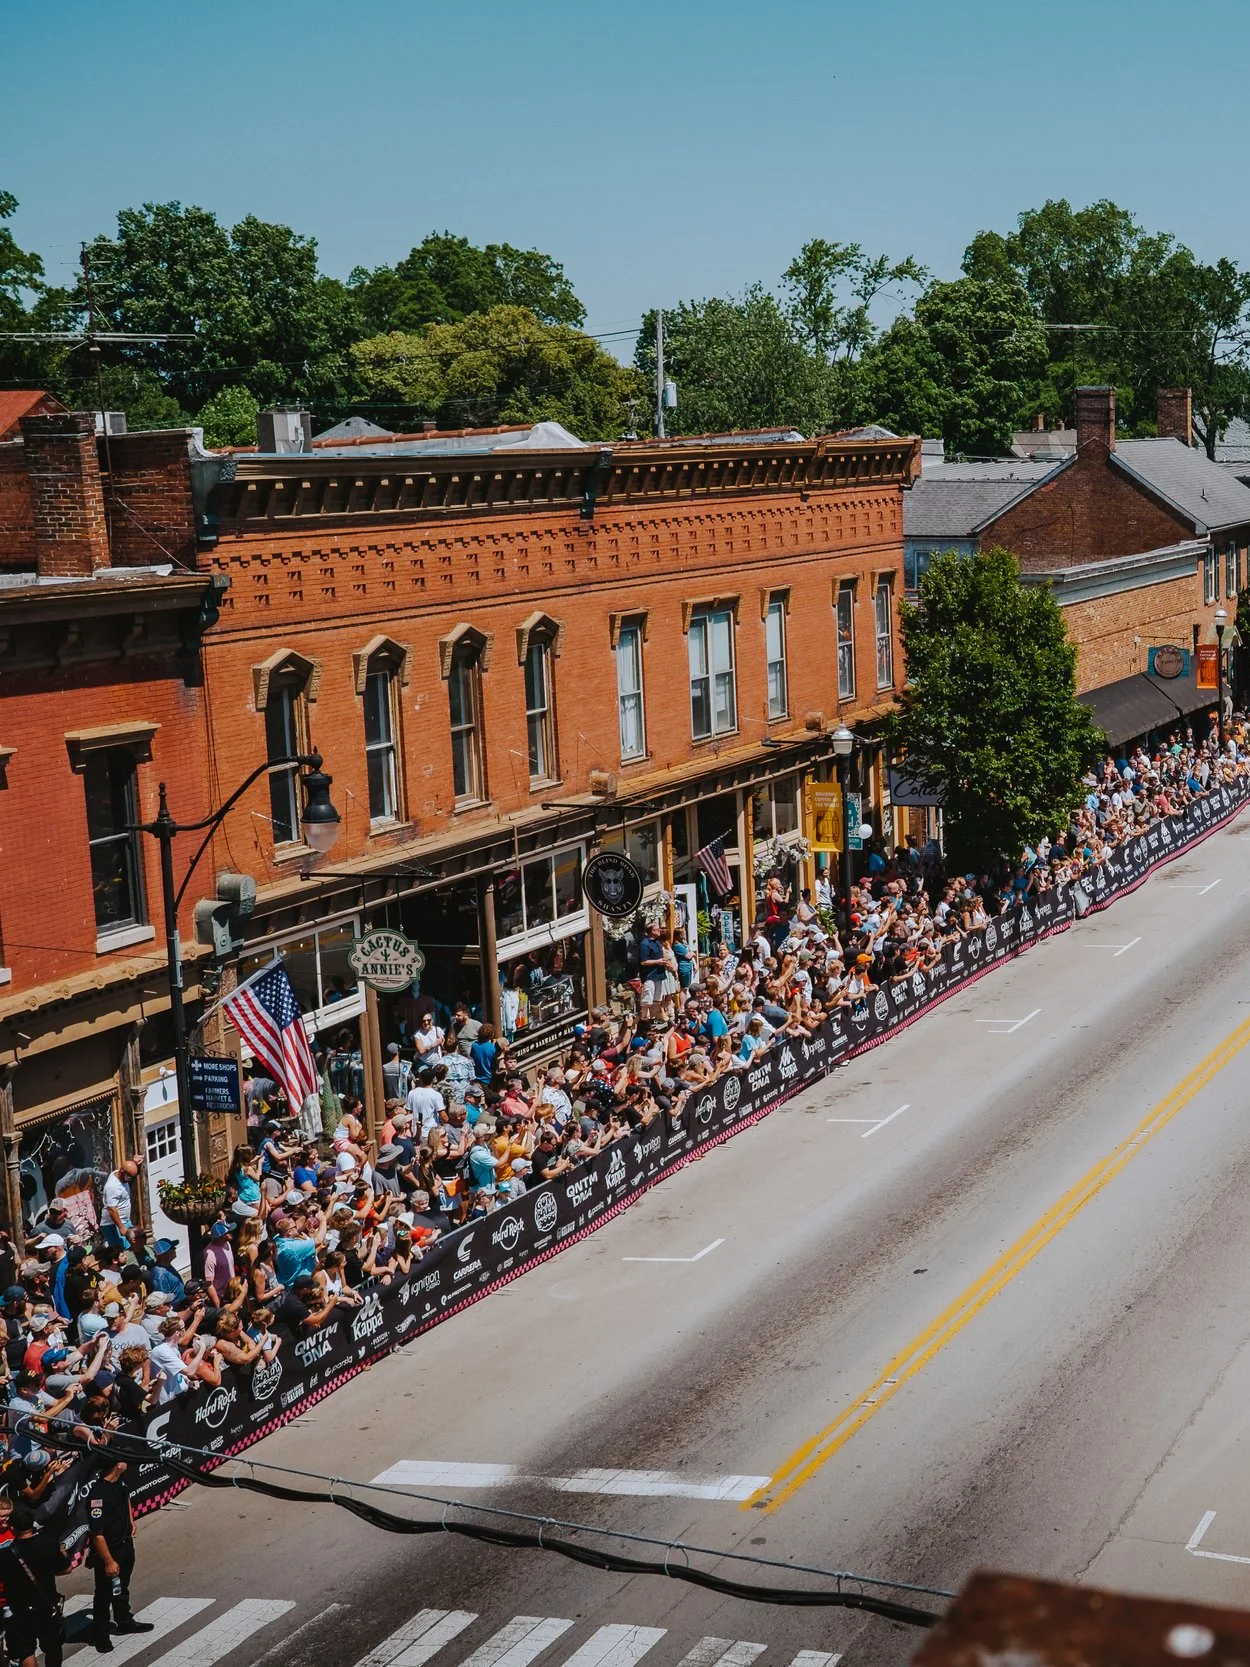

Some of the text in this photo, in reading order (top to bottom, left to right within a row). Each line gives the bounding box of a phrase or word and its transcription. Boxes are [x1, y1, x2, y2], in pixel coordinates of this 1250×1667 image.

[588, 864, 599, 878] THE
[598, 857, 618, 866] BLIND
[361, 936, 411, 957] CACTUS
[362, 963, 413, 976] ANNIE'S
[203, 1063, 237, 1072] MORE SHOPS
[748, 1062, 772, 1083] QNTM
[204, 1075, 228, 1083] PARKING
[751, 1075, 770, 1092] DNA
[566, 1171, 598, 1198] QNTM
[605, 1167, 626, 1189] Kappa
[572, 1187, 593, 1208] DNA
[492, 1217, 524, 1245] Hard Rock
[453, 1259, 482, 1280] CARRERA
[410, 1270, 440, 1296] ignition
[353, 1312, 384, 1341] Kappa
[295, 1321, 338, 1356] QNTM
[301, 1340, 332, 1368] DNA
[195, 1386, 237, 1423] Hard Rock
[136, 1474, 170, 1495] PROTOCOL
